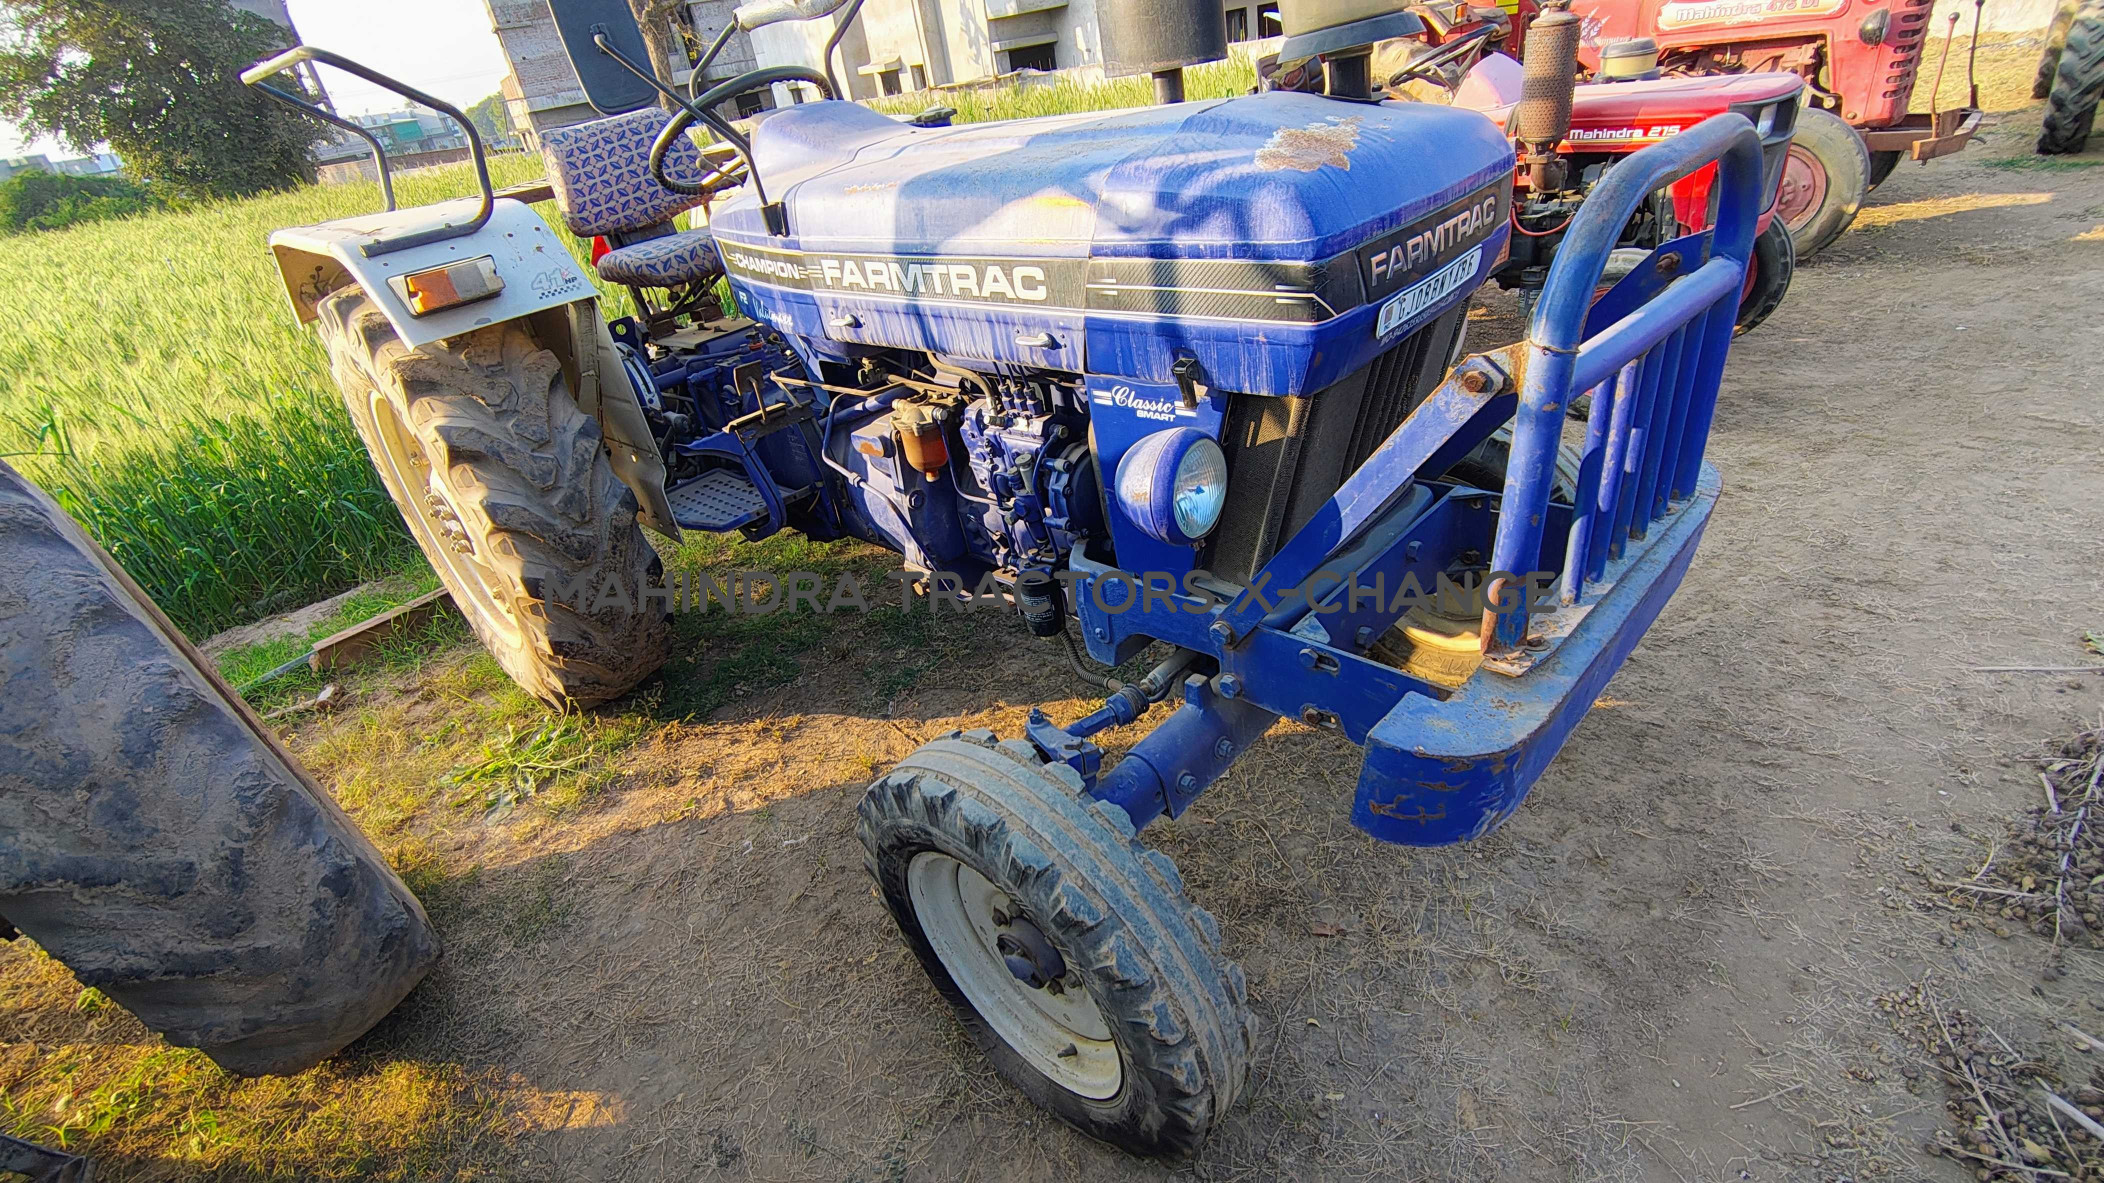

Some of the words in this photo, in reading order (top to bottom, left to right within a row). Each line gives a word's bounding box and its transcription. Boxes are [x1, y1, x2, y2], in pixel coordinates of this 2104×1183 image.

[1676, 4, 1762, 21] Mahindra
[1569, 128, 1644, 139] Mahindra
[1648, 125, 1681, 136] 215
[1371, 196, 1496, 287] FARMTRAC
[735, 253, 800, 279] CHAMPION
[531, 268, 565, 291] 41
[565, 276, 577, 285] HP
[820, 259, 1048, 301] FARMTRAC
[1111, 385, 1175, 414] Classic
[1136, 409, 1176, 422] SMART
